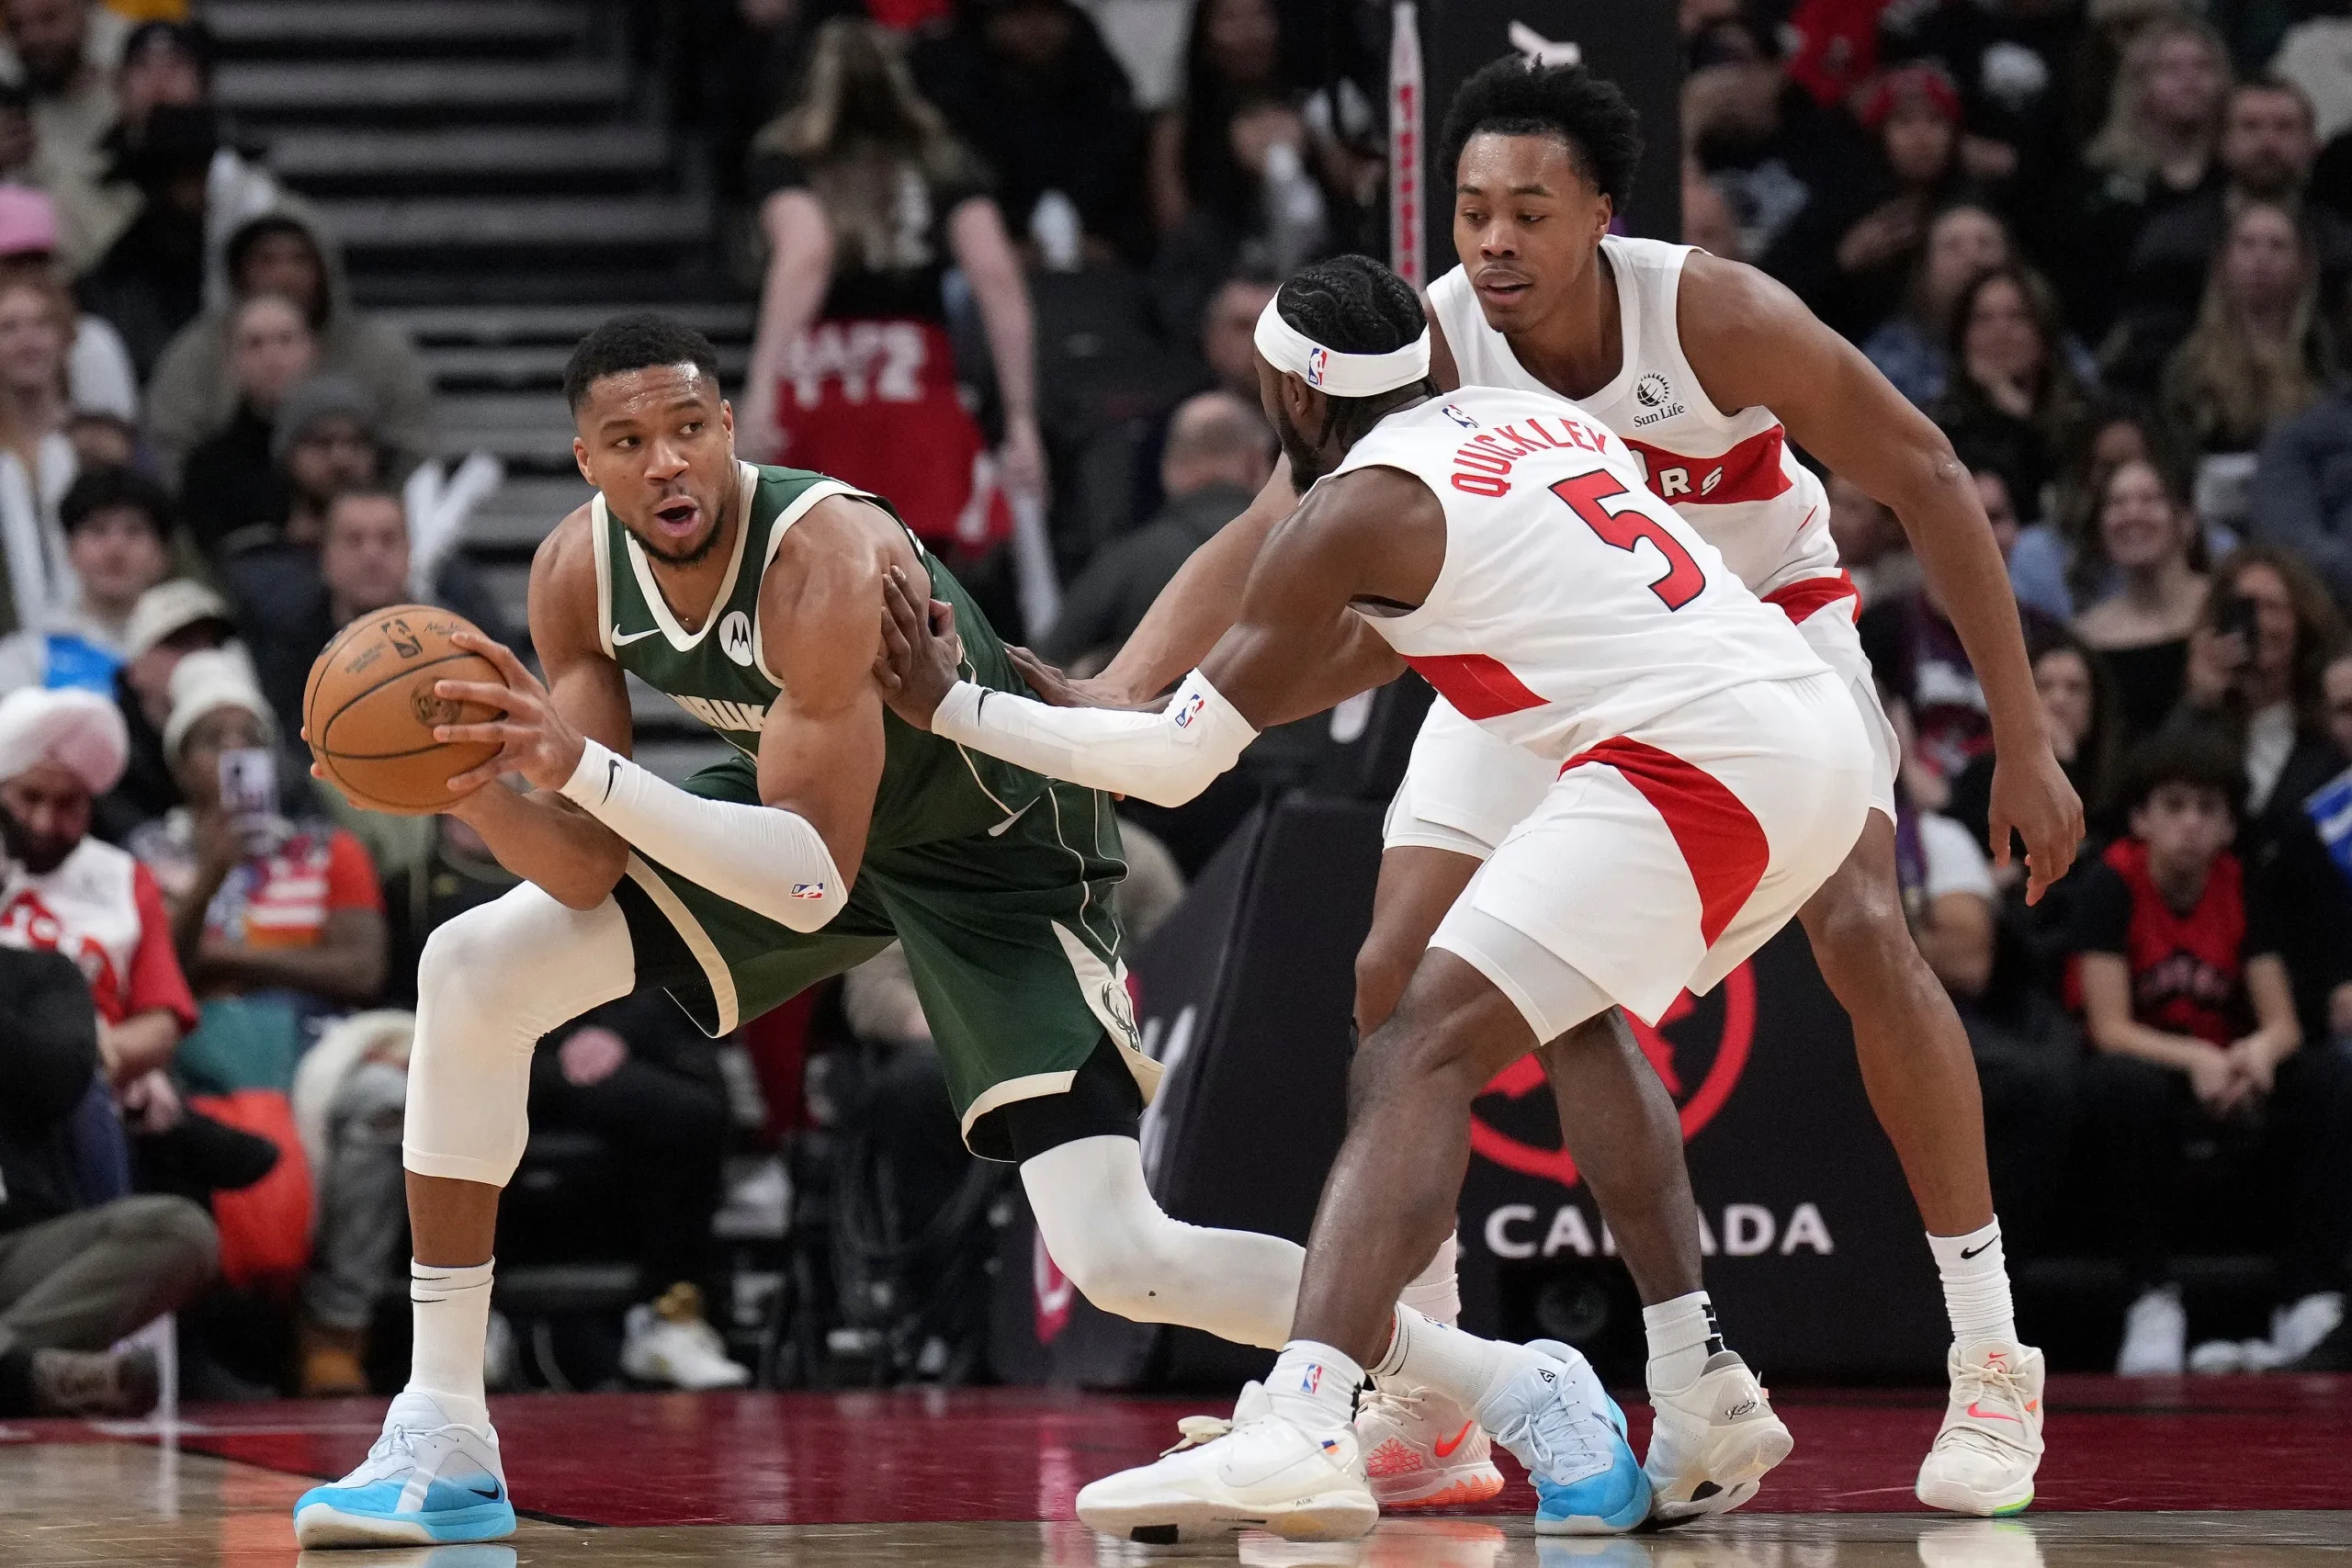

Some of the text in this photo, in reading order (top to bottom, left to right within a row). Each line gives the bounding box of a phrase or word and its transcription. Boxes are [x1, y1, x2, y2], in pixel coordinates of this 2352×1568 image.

[1634, 403, 1685, 427] Sun Life
[1451, 418, 1607, 497] QUICKLEY
[1547, 468, 1706, 613] 5
